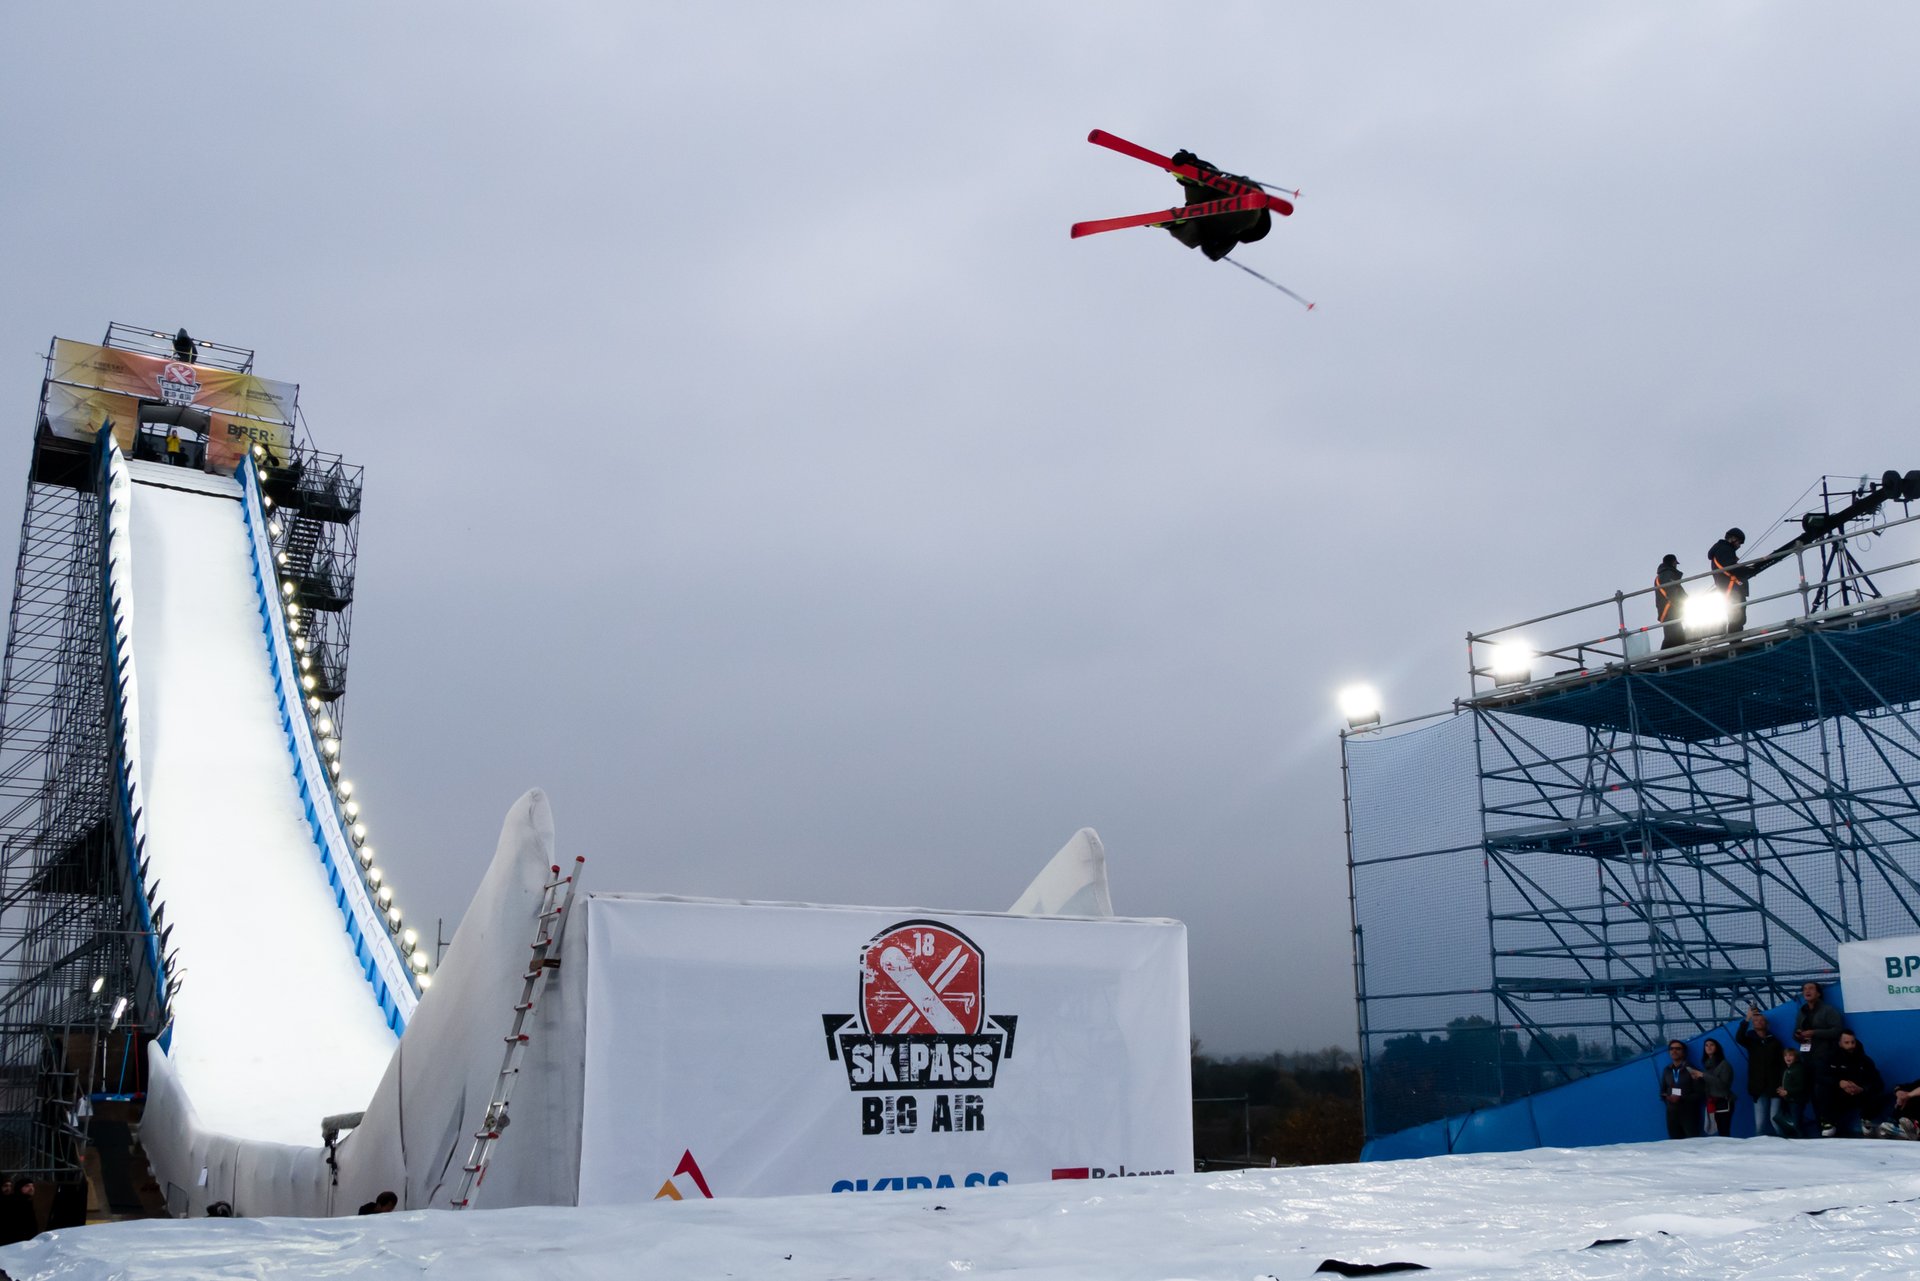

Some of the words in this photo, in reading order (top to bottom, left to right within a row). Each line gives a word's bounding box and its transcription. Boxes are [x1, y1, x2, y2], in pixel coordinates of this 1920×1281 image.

[913, 933, 935, 956] 18
[1887, 984, 1920, 995] Banca
[852, 1043, 993, 1083] SKIPASS
[862, 1095, 917, 1135] BIG
[931, 1094, 985, 1133] AIR
